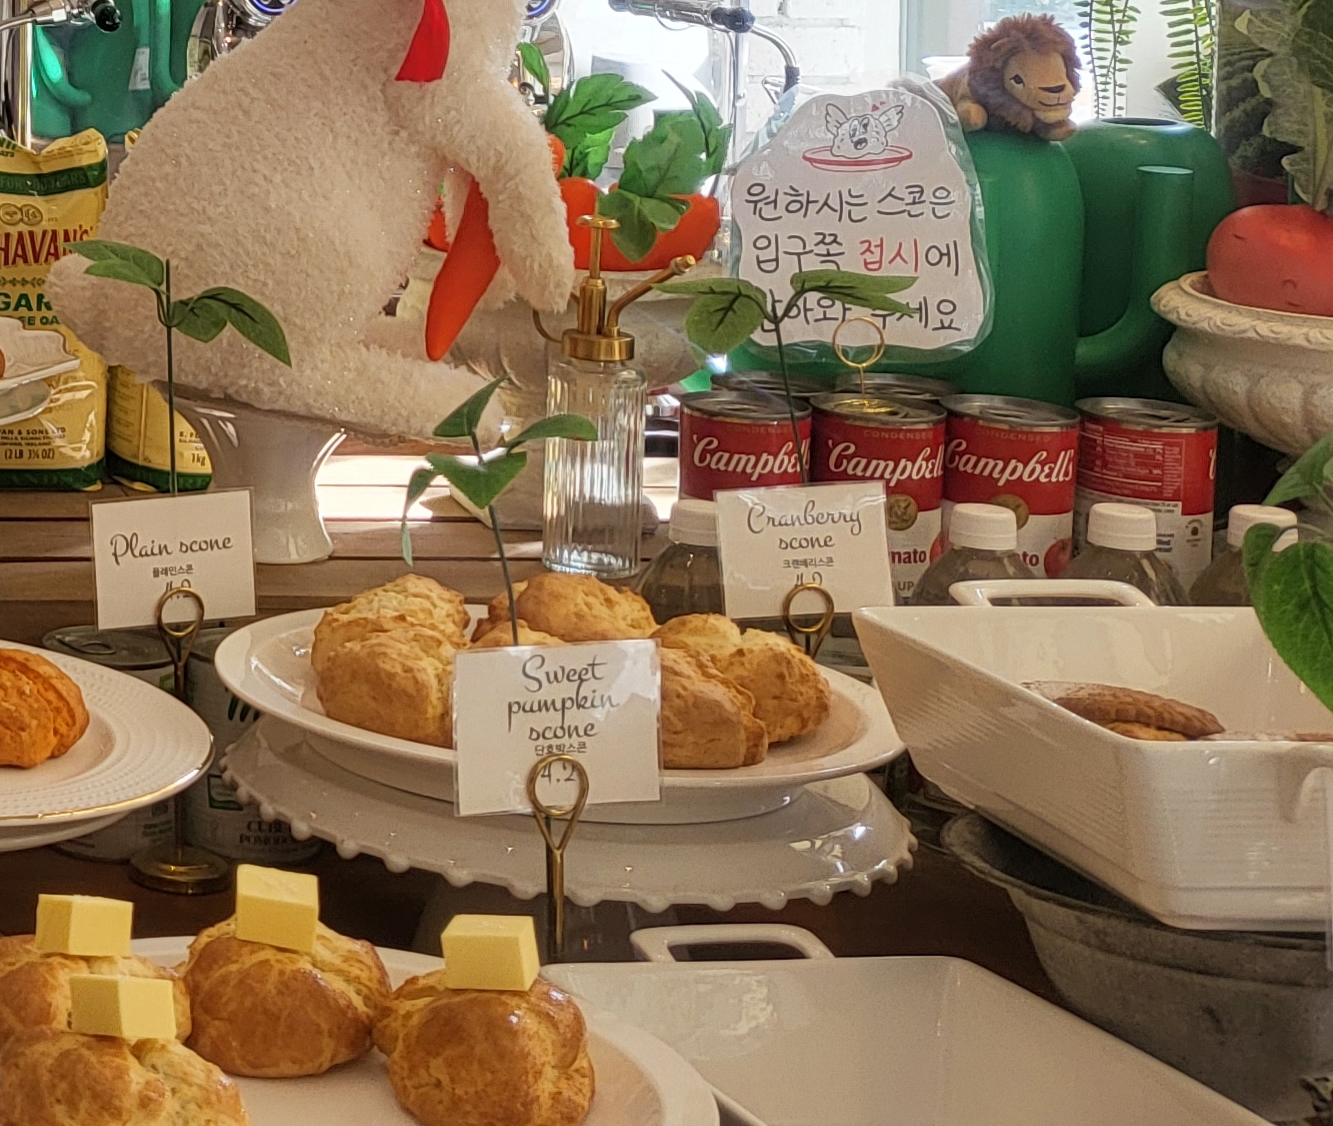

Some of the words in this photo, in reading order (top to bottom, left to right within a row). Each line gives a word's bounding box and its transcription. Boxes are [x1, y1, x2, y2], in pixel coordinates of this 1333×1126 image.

[744, 182, 869, 224] 원하시는
[876, 184, 956, 220] 스콘은
[751, 231, 846, 276] 입구쪽
[858, 236, 961, 277] 접시에
[944, 438, 1074, 485] Campbell's
[747, 499, 862, 536] Cranberry
[110, 531, 174, 566] Plain
[178, 536, 234, 555] scone
[778, 535, 836, 550] scone
[152, 564, 195, 578] 플레인스콘
[521, 654, 608, 693] Sweet
[507, 684, 620, 734] pumpkin
[528, 722, 599, 741] scone
[534, 741, 588, 756] 단호박스콘
[539, 760, 578, 784] 4.2
